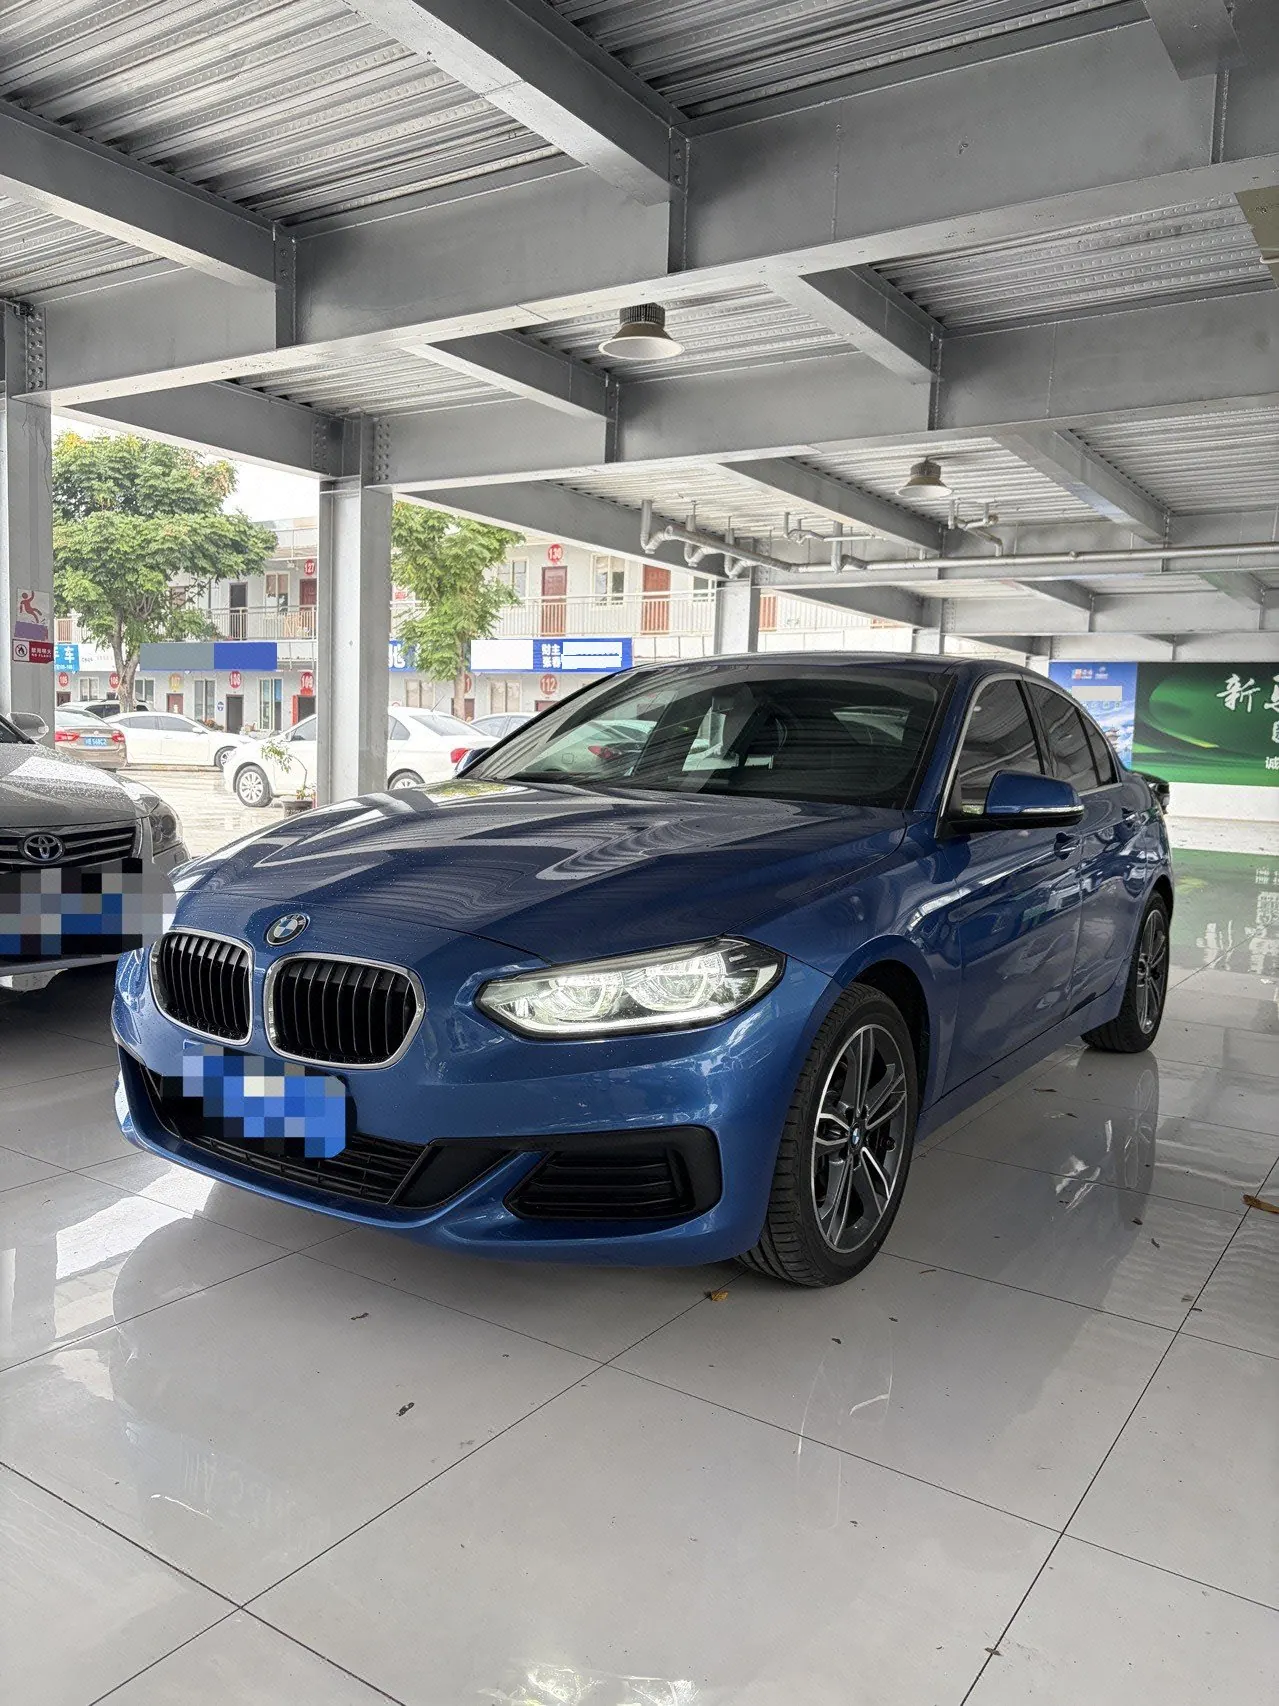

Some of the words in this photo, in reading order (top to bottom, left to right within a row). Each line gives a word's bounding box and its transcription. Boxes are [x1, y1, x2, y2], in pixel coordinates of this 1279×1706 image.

[548, 547, 562, 560] 130
[304, 562, 315, 574] 127
[301, 676, 313, 688] 109
[541, 678, 556, 692] 112
